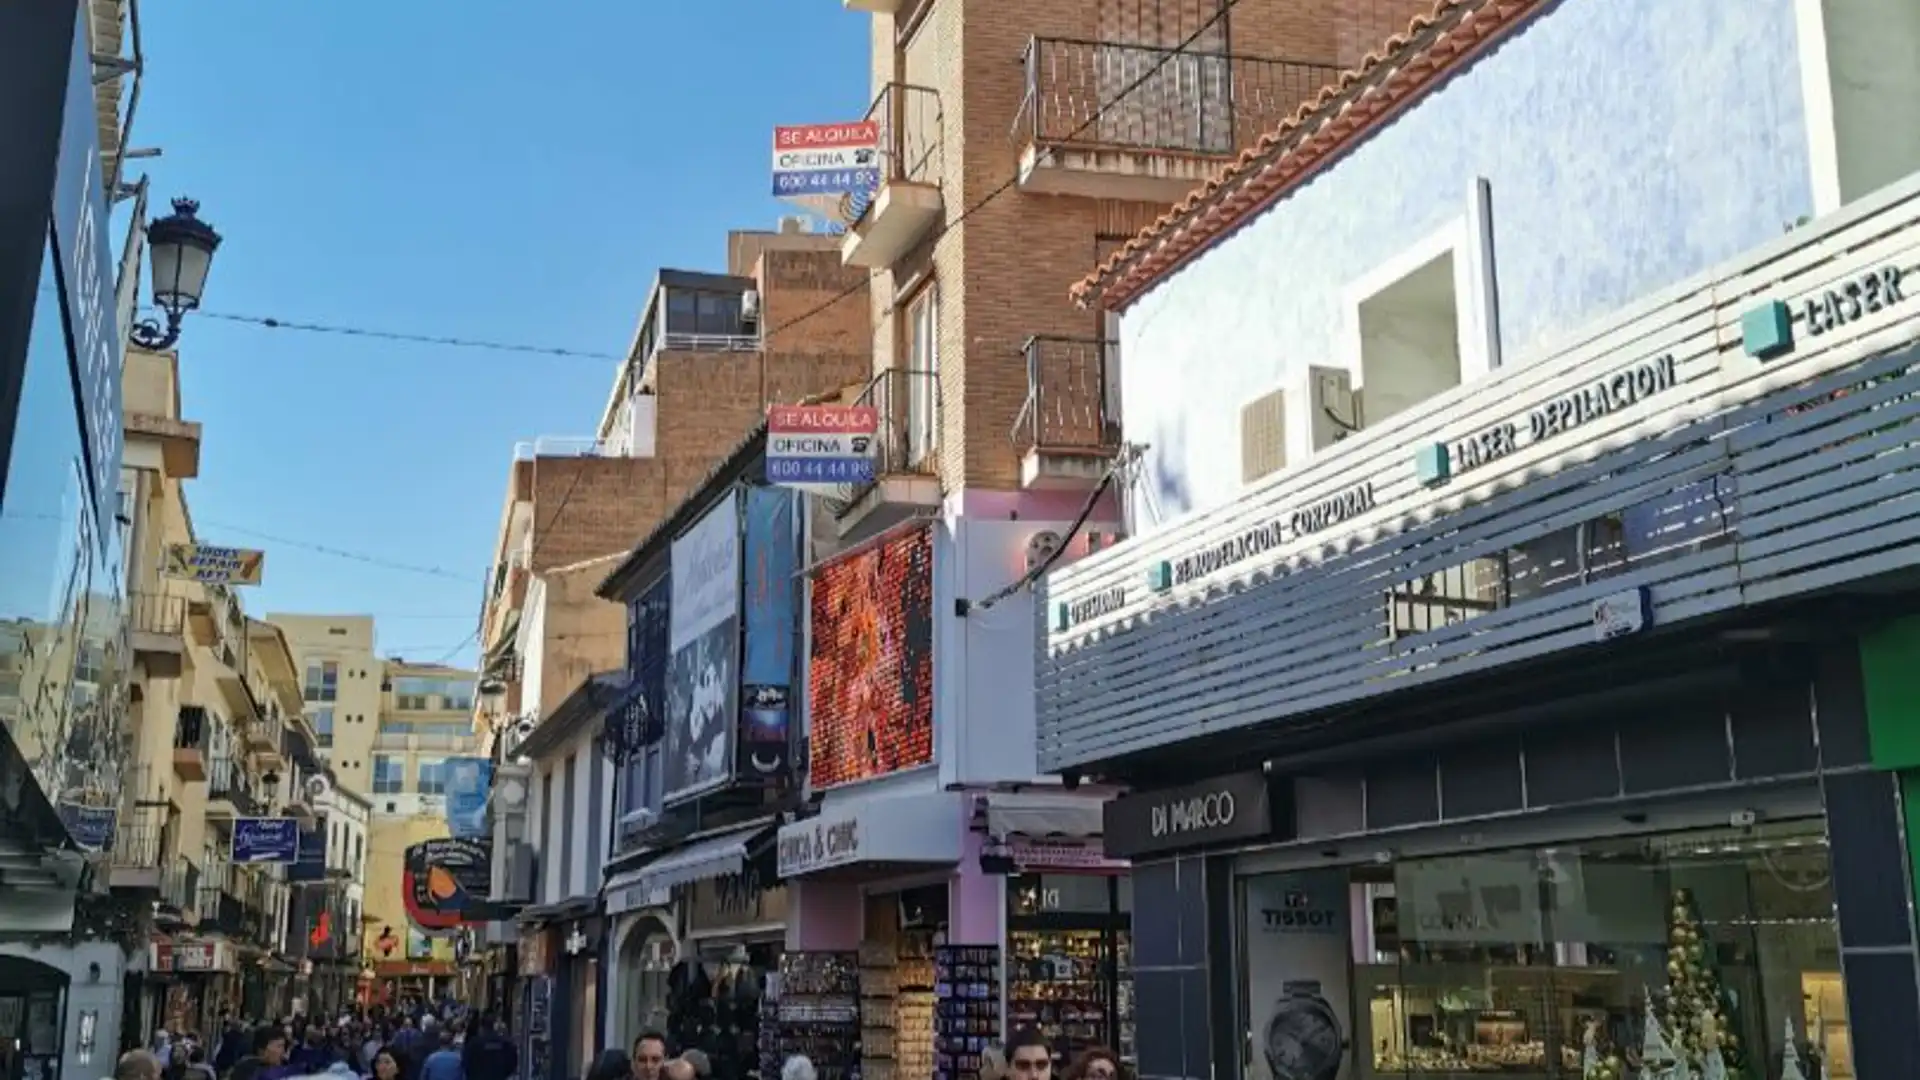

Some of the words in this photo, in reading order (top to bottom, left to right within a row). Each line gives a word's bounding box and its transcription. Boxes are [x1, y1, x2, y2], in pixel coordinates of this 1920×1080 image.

[779, 131, 801, 145] SE
[804, 127, 875, 142] ALQUILA
[779, 153, 846, 168] OFICINA
[779, 174, 807, 189] 600
[810, 173, 828, 186] 44
[831, 171, 850, 186] 44
[1804, 265, 1904, 336] LASER
[775, 412, 799, 426] SE
[800, 410, 872, 427] ALQUILA
[1457, 422, 1517, 473] LASER
[1530, 353, 1677, 443] DEPILACION
[774, 438, 841, 453] OFICINA
[771, 461, 800, 476] 600
[803, 462, 822, 476] 44
[827, 462, 845, 476] 44
[1291, 481, 1376, 538] CORPORAL
[1151, 803, 1168, 837] DI
[1171, 790, 1234, 833] MARCO
[1261, 909, 1335, 927] TISSOT
